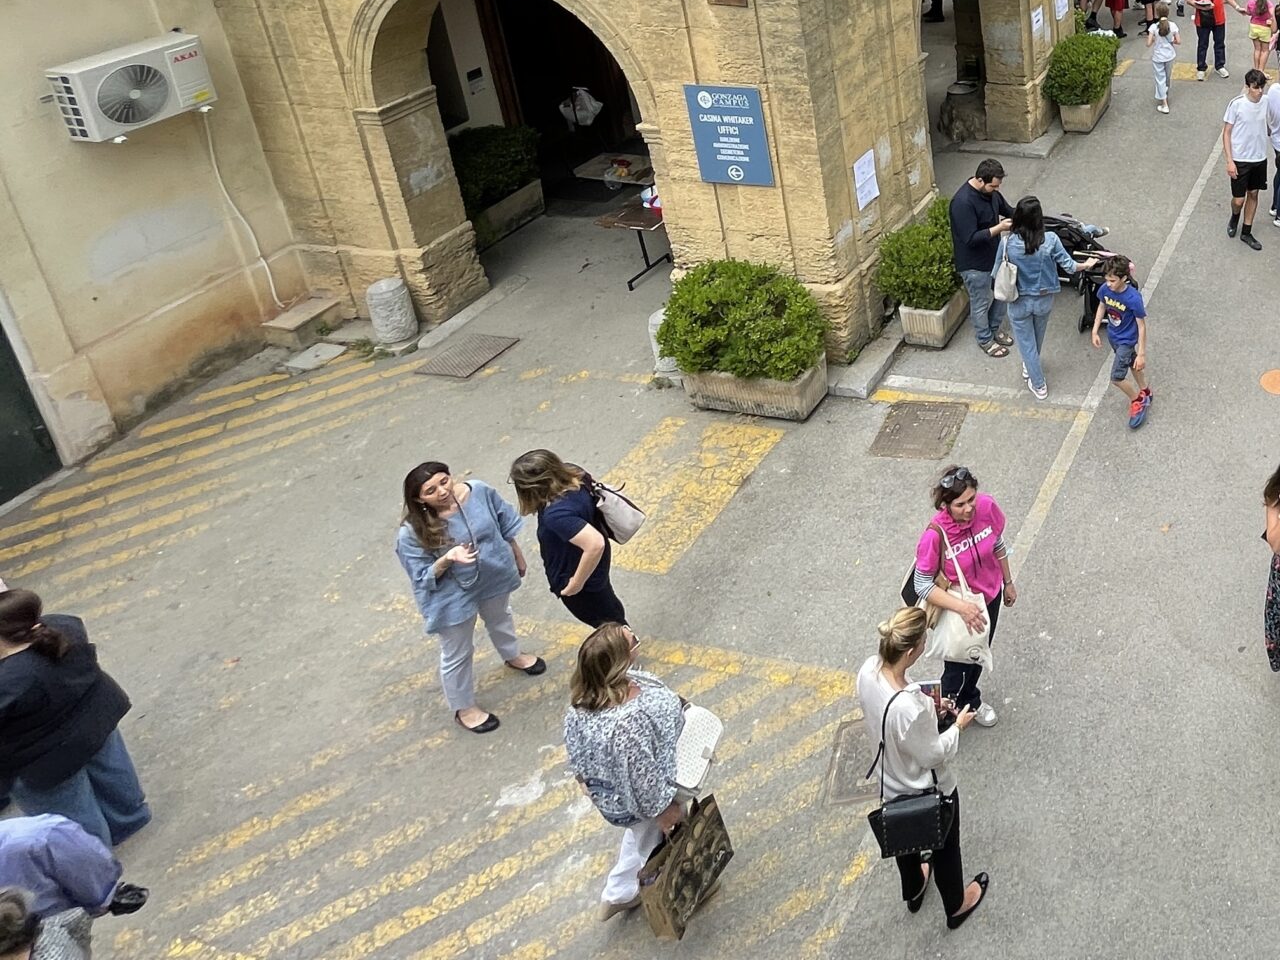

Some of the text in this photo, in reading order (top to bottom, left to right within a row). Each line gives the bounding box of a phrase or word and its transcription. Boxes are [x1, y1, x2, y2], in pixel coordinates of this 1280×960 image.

[173, 50, 198, 64] AKAI
[711, 93, 748, 101] GONZAGA
[699, 114, 754, 125] CASINA WHITAKER
[717, 126, 739, 135] UFFICI
